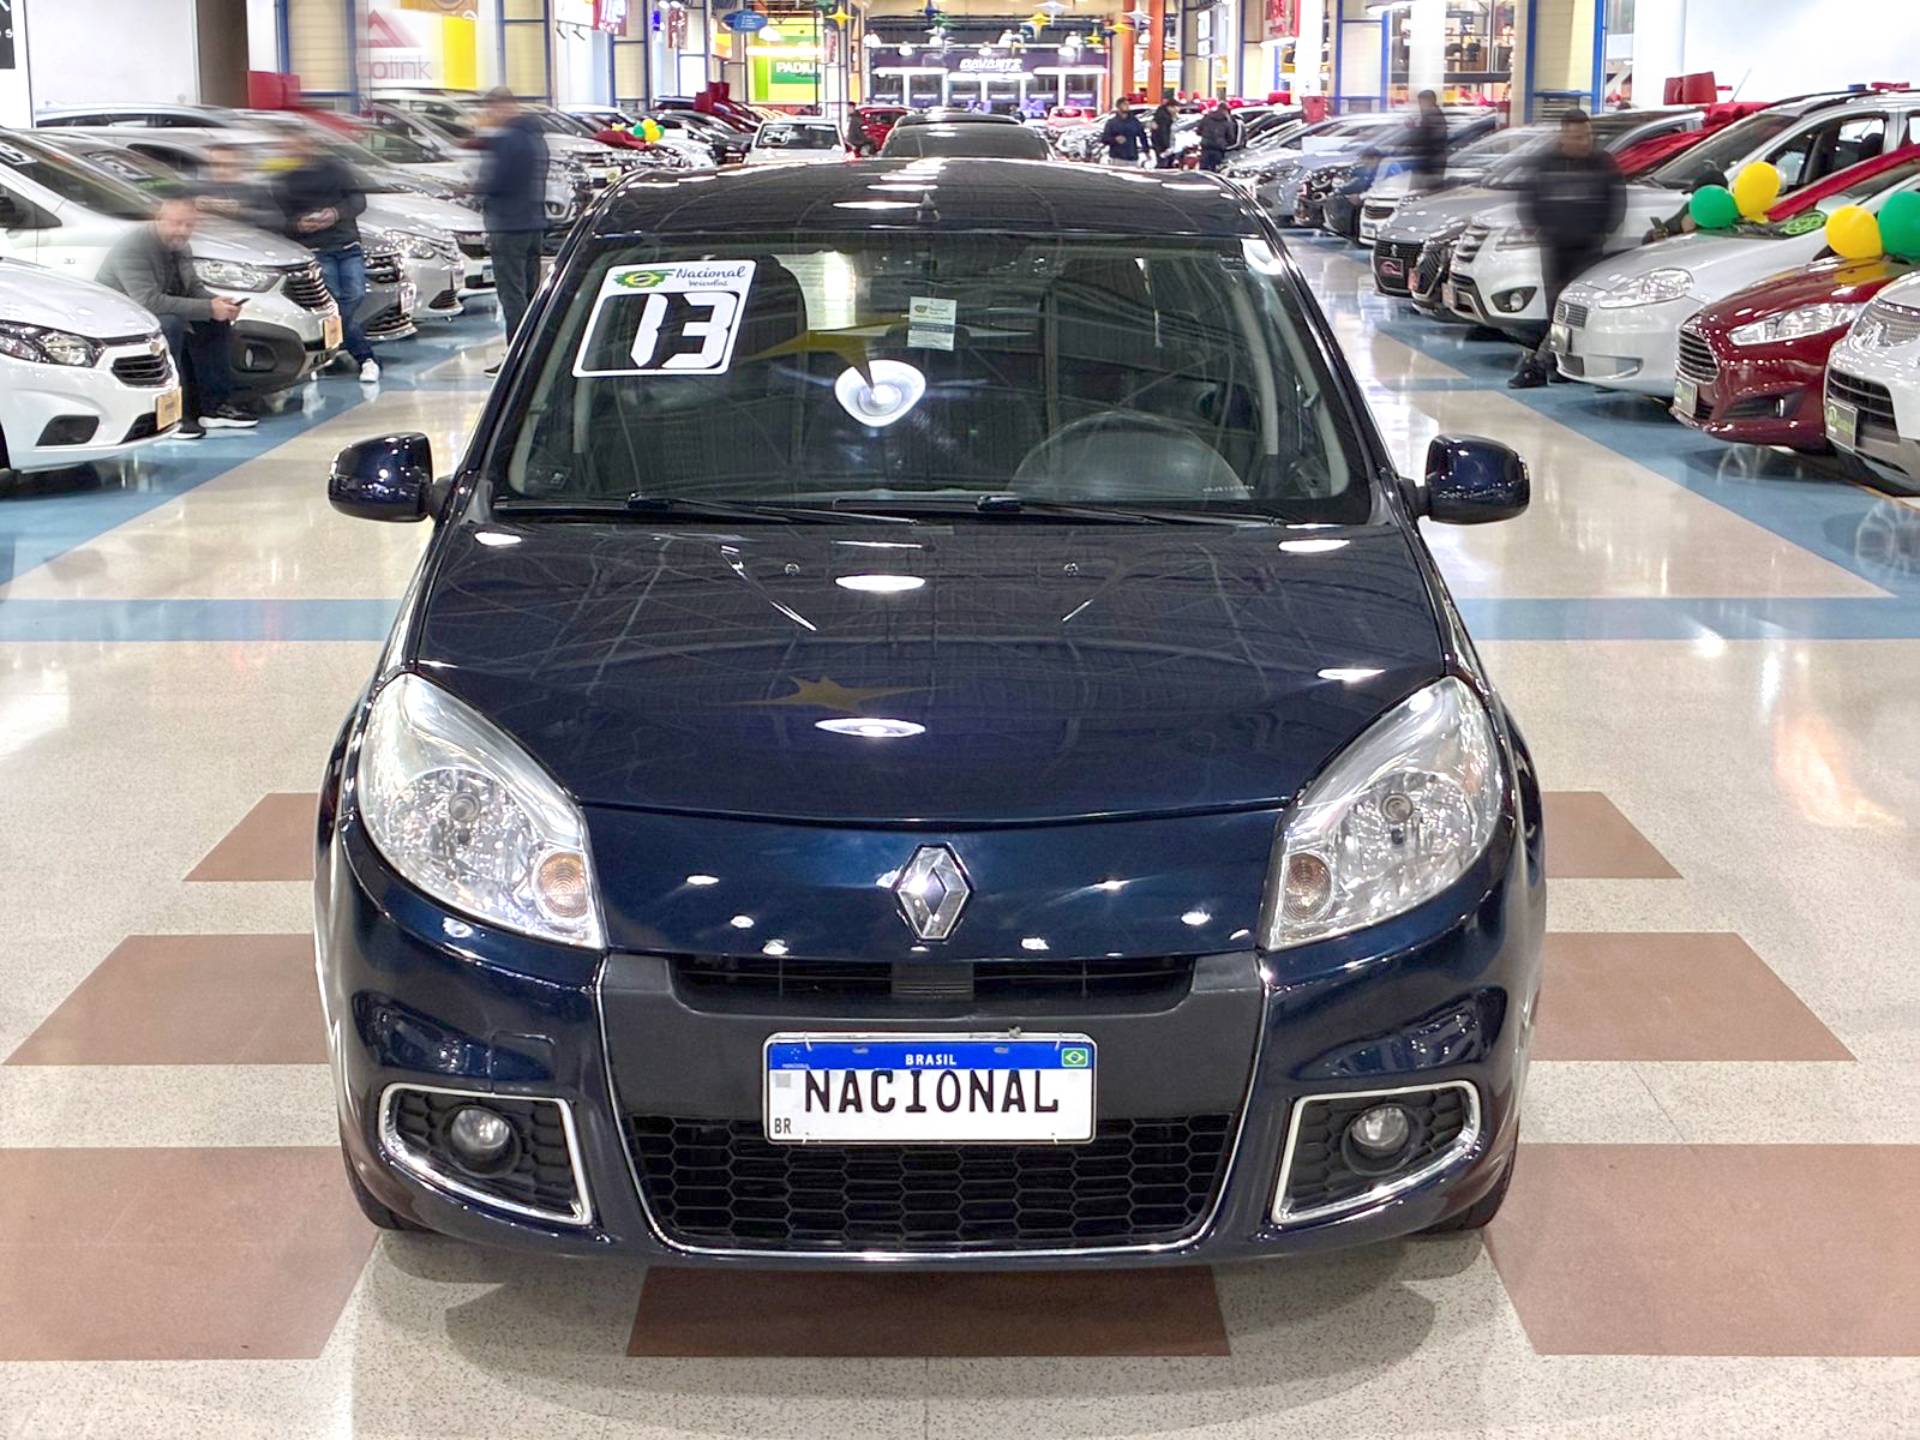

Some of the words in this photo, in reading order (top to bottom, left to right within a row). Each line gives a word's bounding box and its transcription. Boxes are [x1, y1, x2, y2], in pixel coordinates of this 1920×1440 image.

[676, 265, 746, 279] Nacional
[630, 292, 738, 369] 13
[905, 1053, 957, 1066] BRASIL
[804, 1069, 1059, 1113] NACIONAL
[774, 1117, 792, 1135] BR
